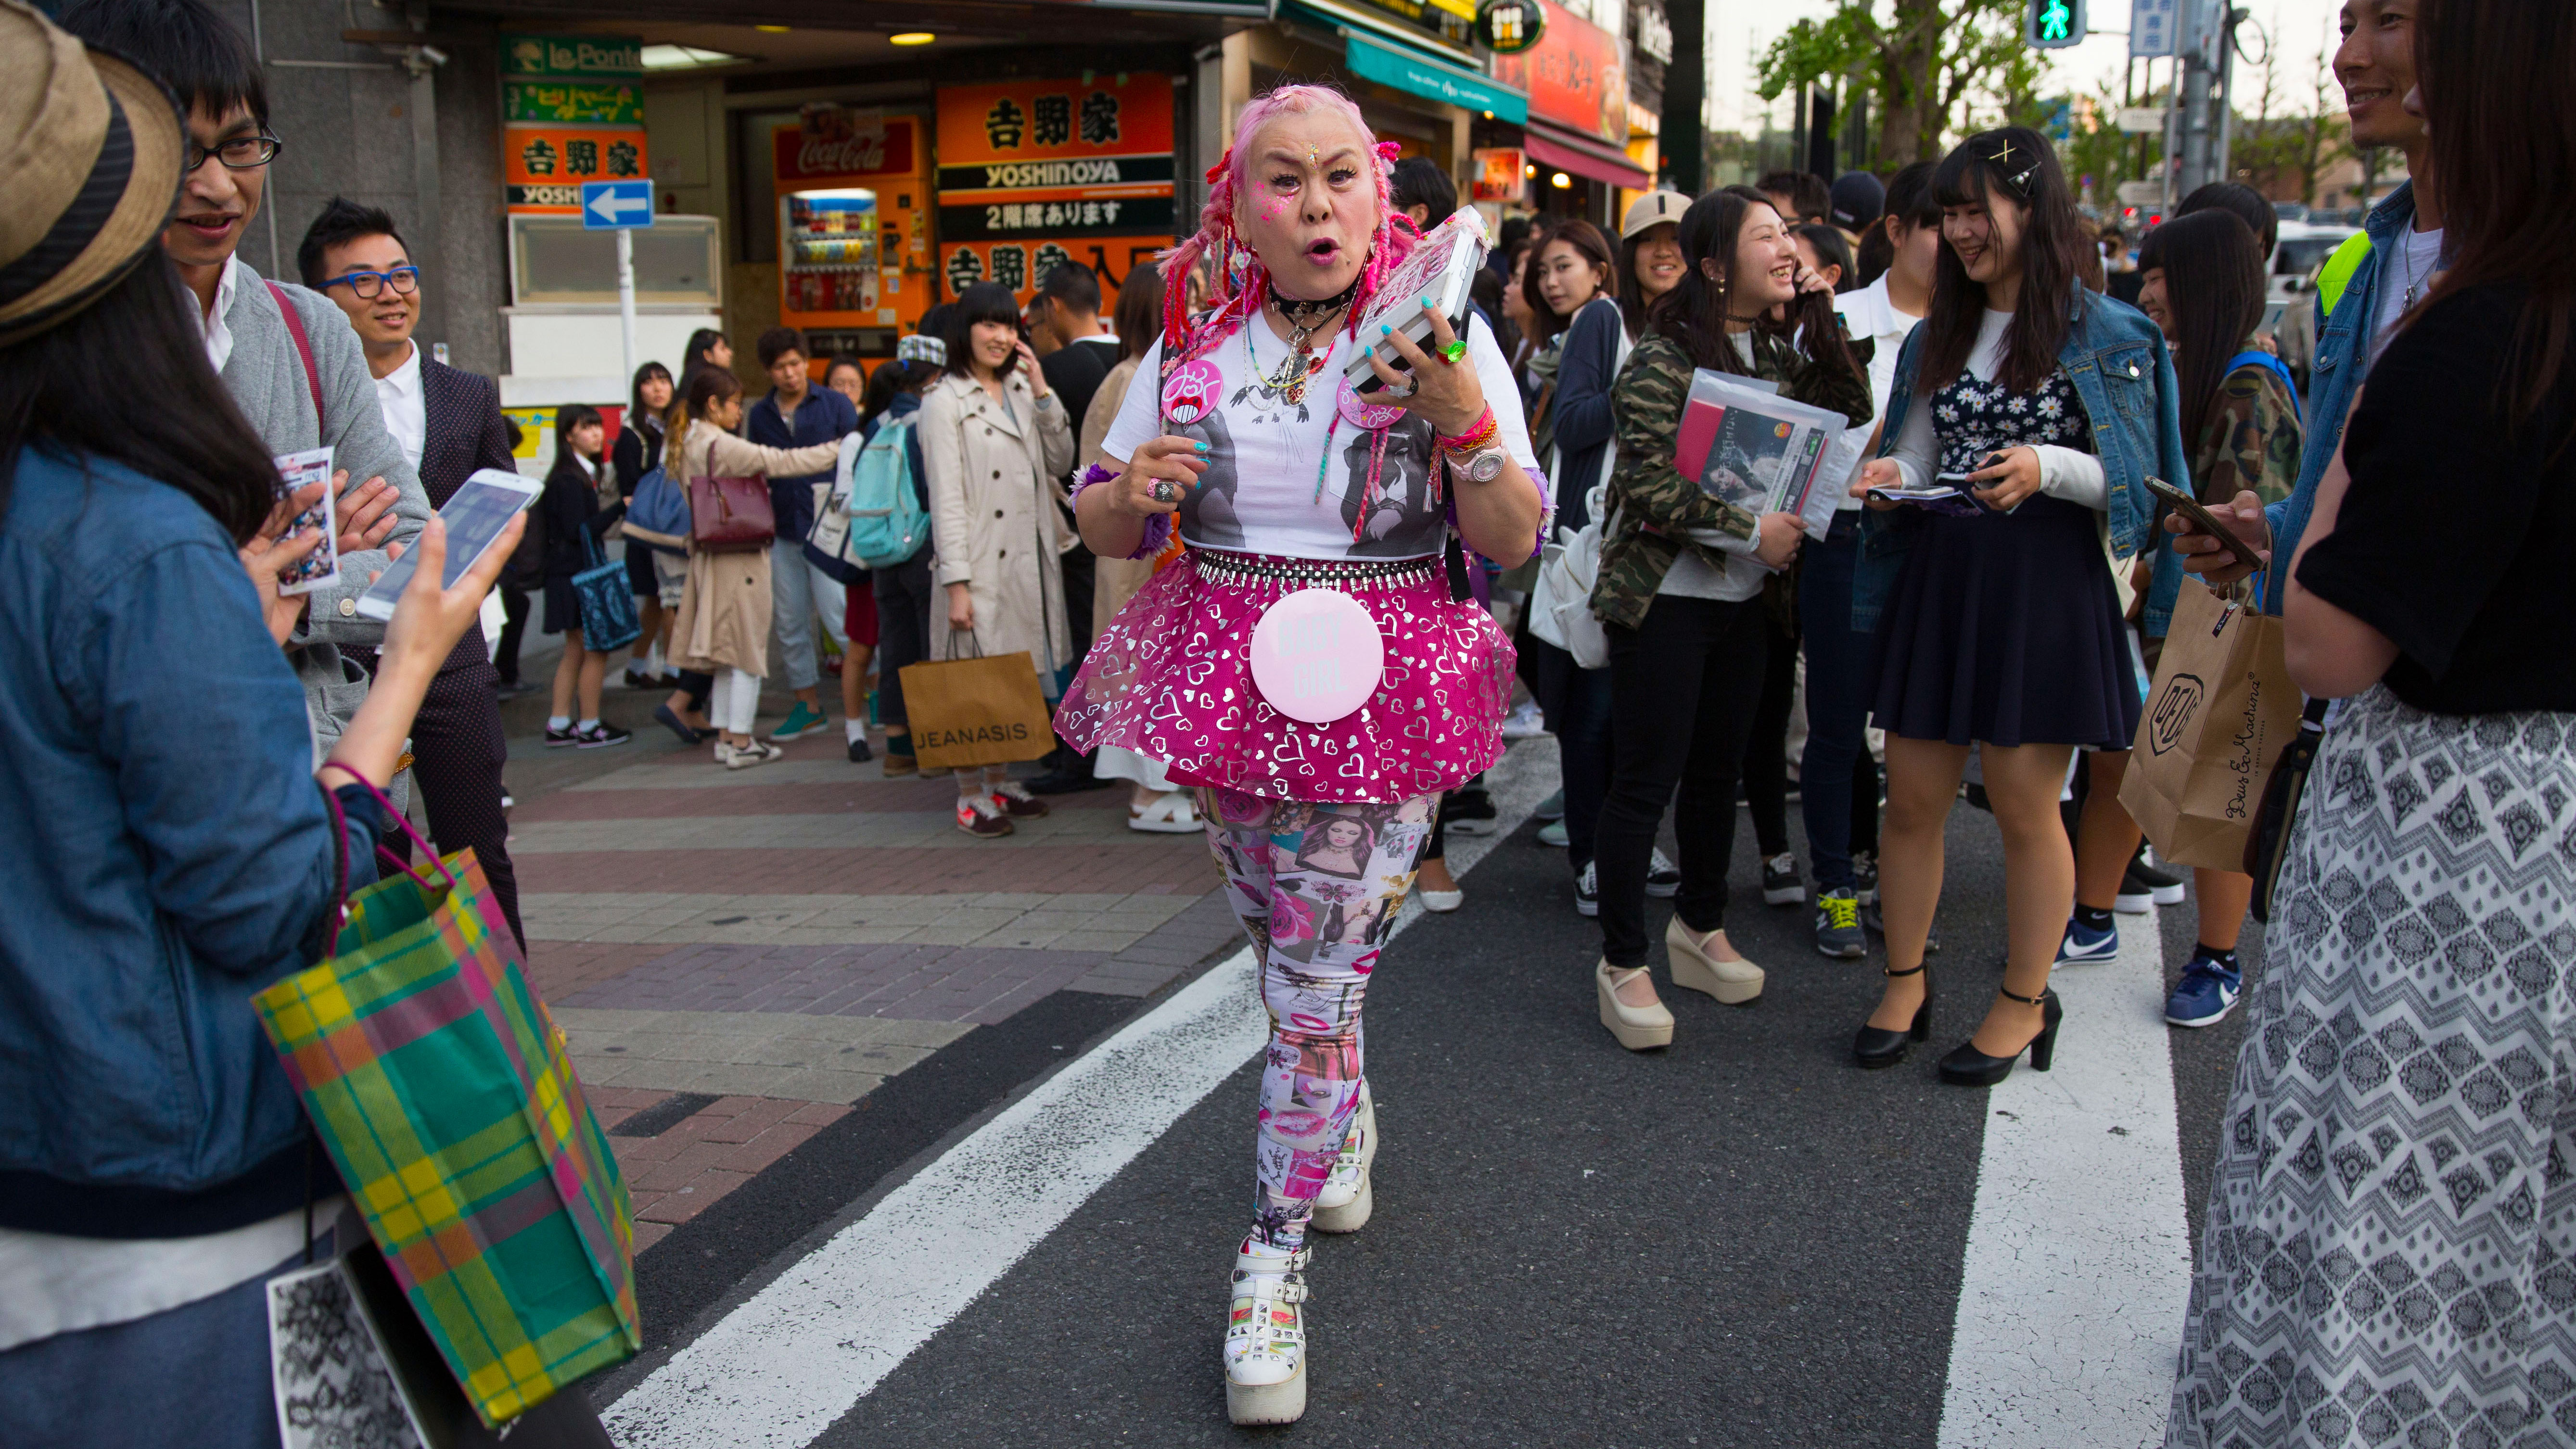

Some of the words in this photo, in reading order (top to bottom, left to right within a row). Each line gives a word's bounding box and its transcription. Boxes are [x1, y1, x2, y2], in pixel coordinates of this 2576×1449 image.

[986, 161, 1120, 188] YOSHINOYA
[987, 201, 1121, 229] 2階席あります
[1278, 612, 1342, 657] BABY
[1294, 657, 1348, 699] GIRL
[917, 723, 1027, 749] JEANASIS
[2230, 755, 2251, 774] Ex
[2226, 775, 2249, 819] Deus
